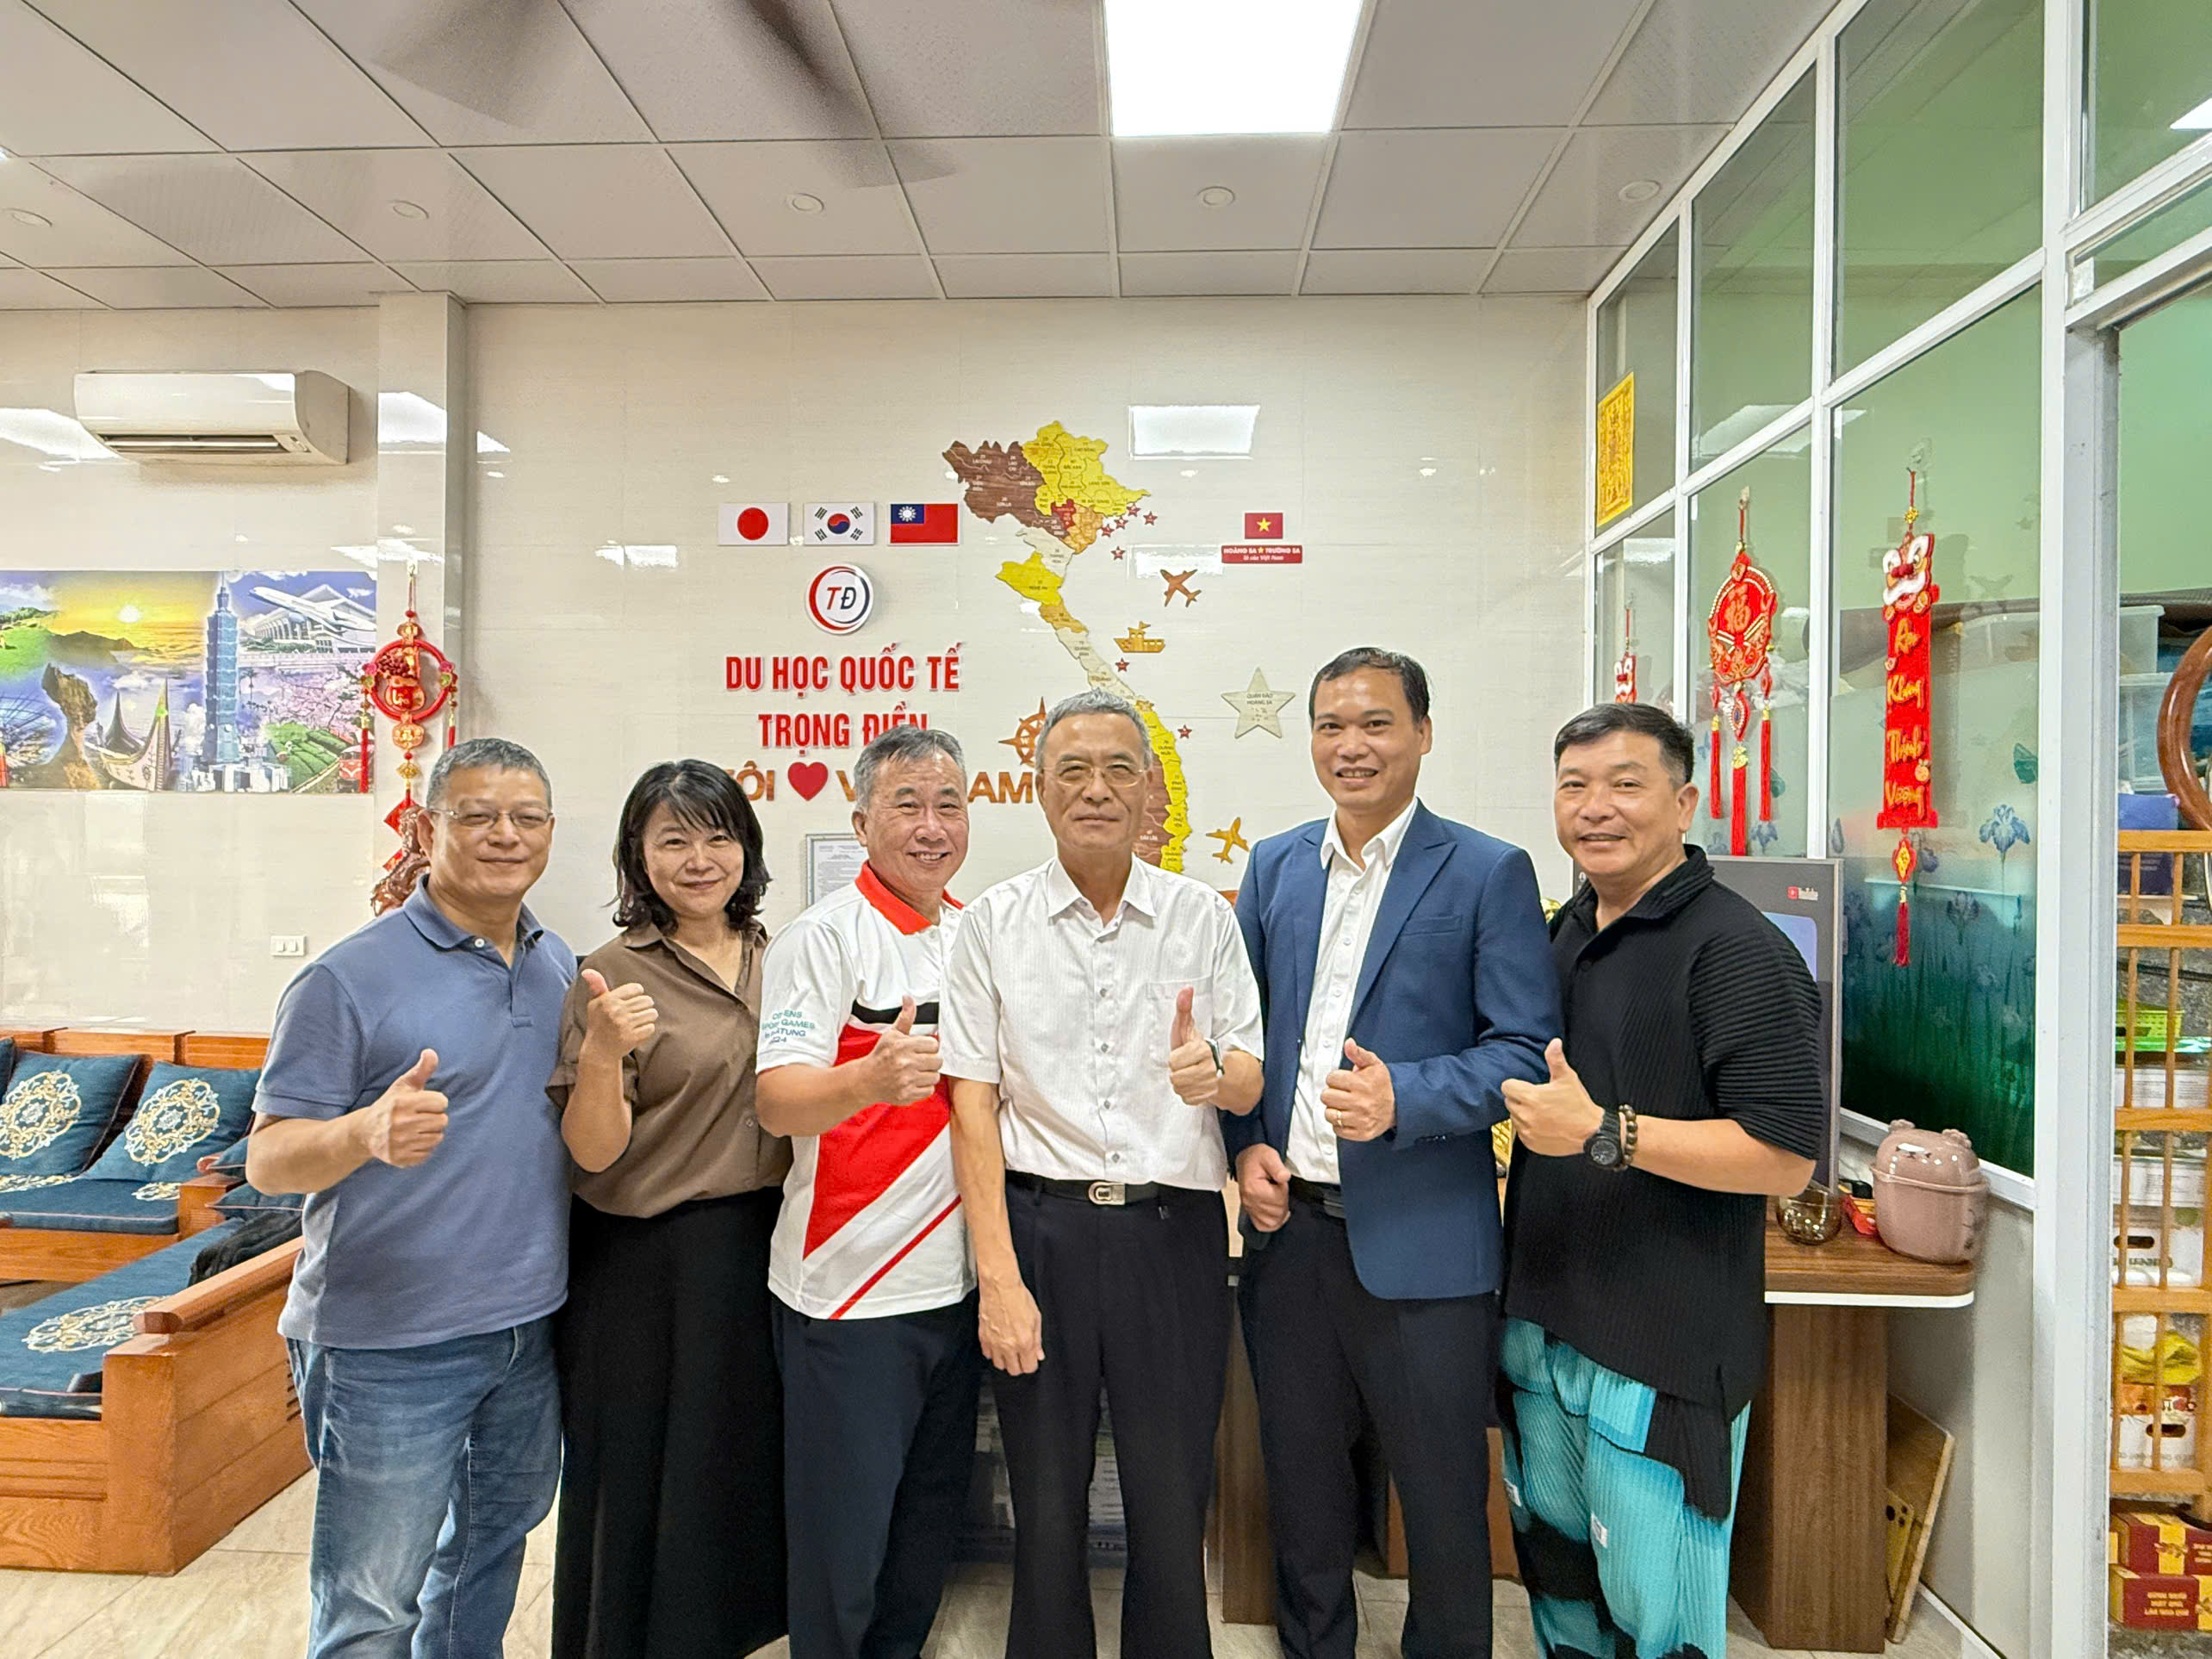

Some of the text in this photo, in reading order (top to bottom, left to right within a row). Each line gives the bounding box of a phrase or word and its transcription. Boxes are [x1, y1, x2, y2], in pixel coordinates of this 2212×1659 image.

[725, 642, 960, 699] DU HỌC QUỐC TẾ
[758, 713, 851, 755] TRỌNG
[725, 761, 1034, 804] ÔI AM
[781, 1019, 815, 1028] GAMES
